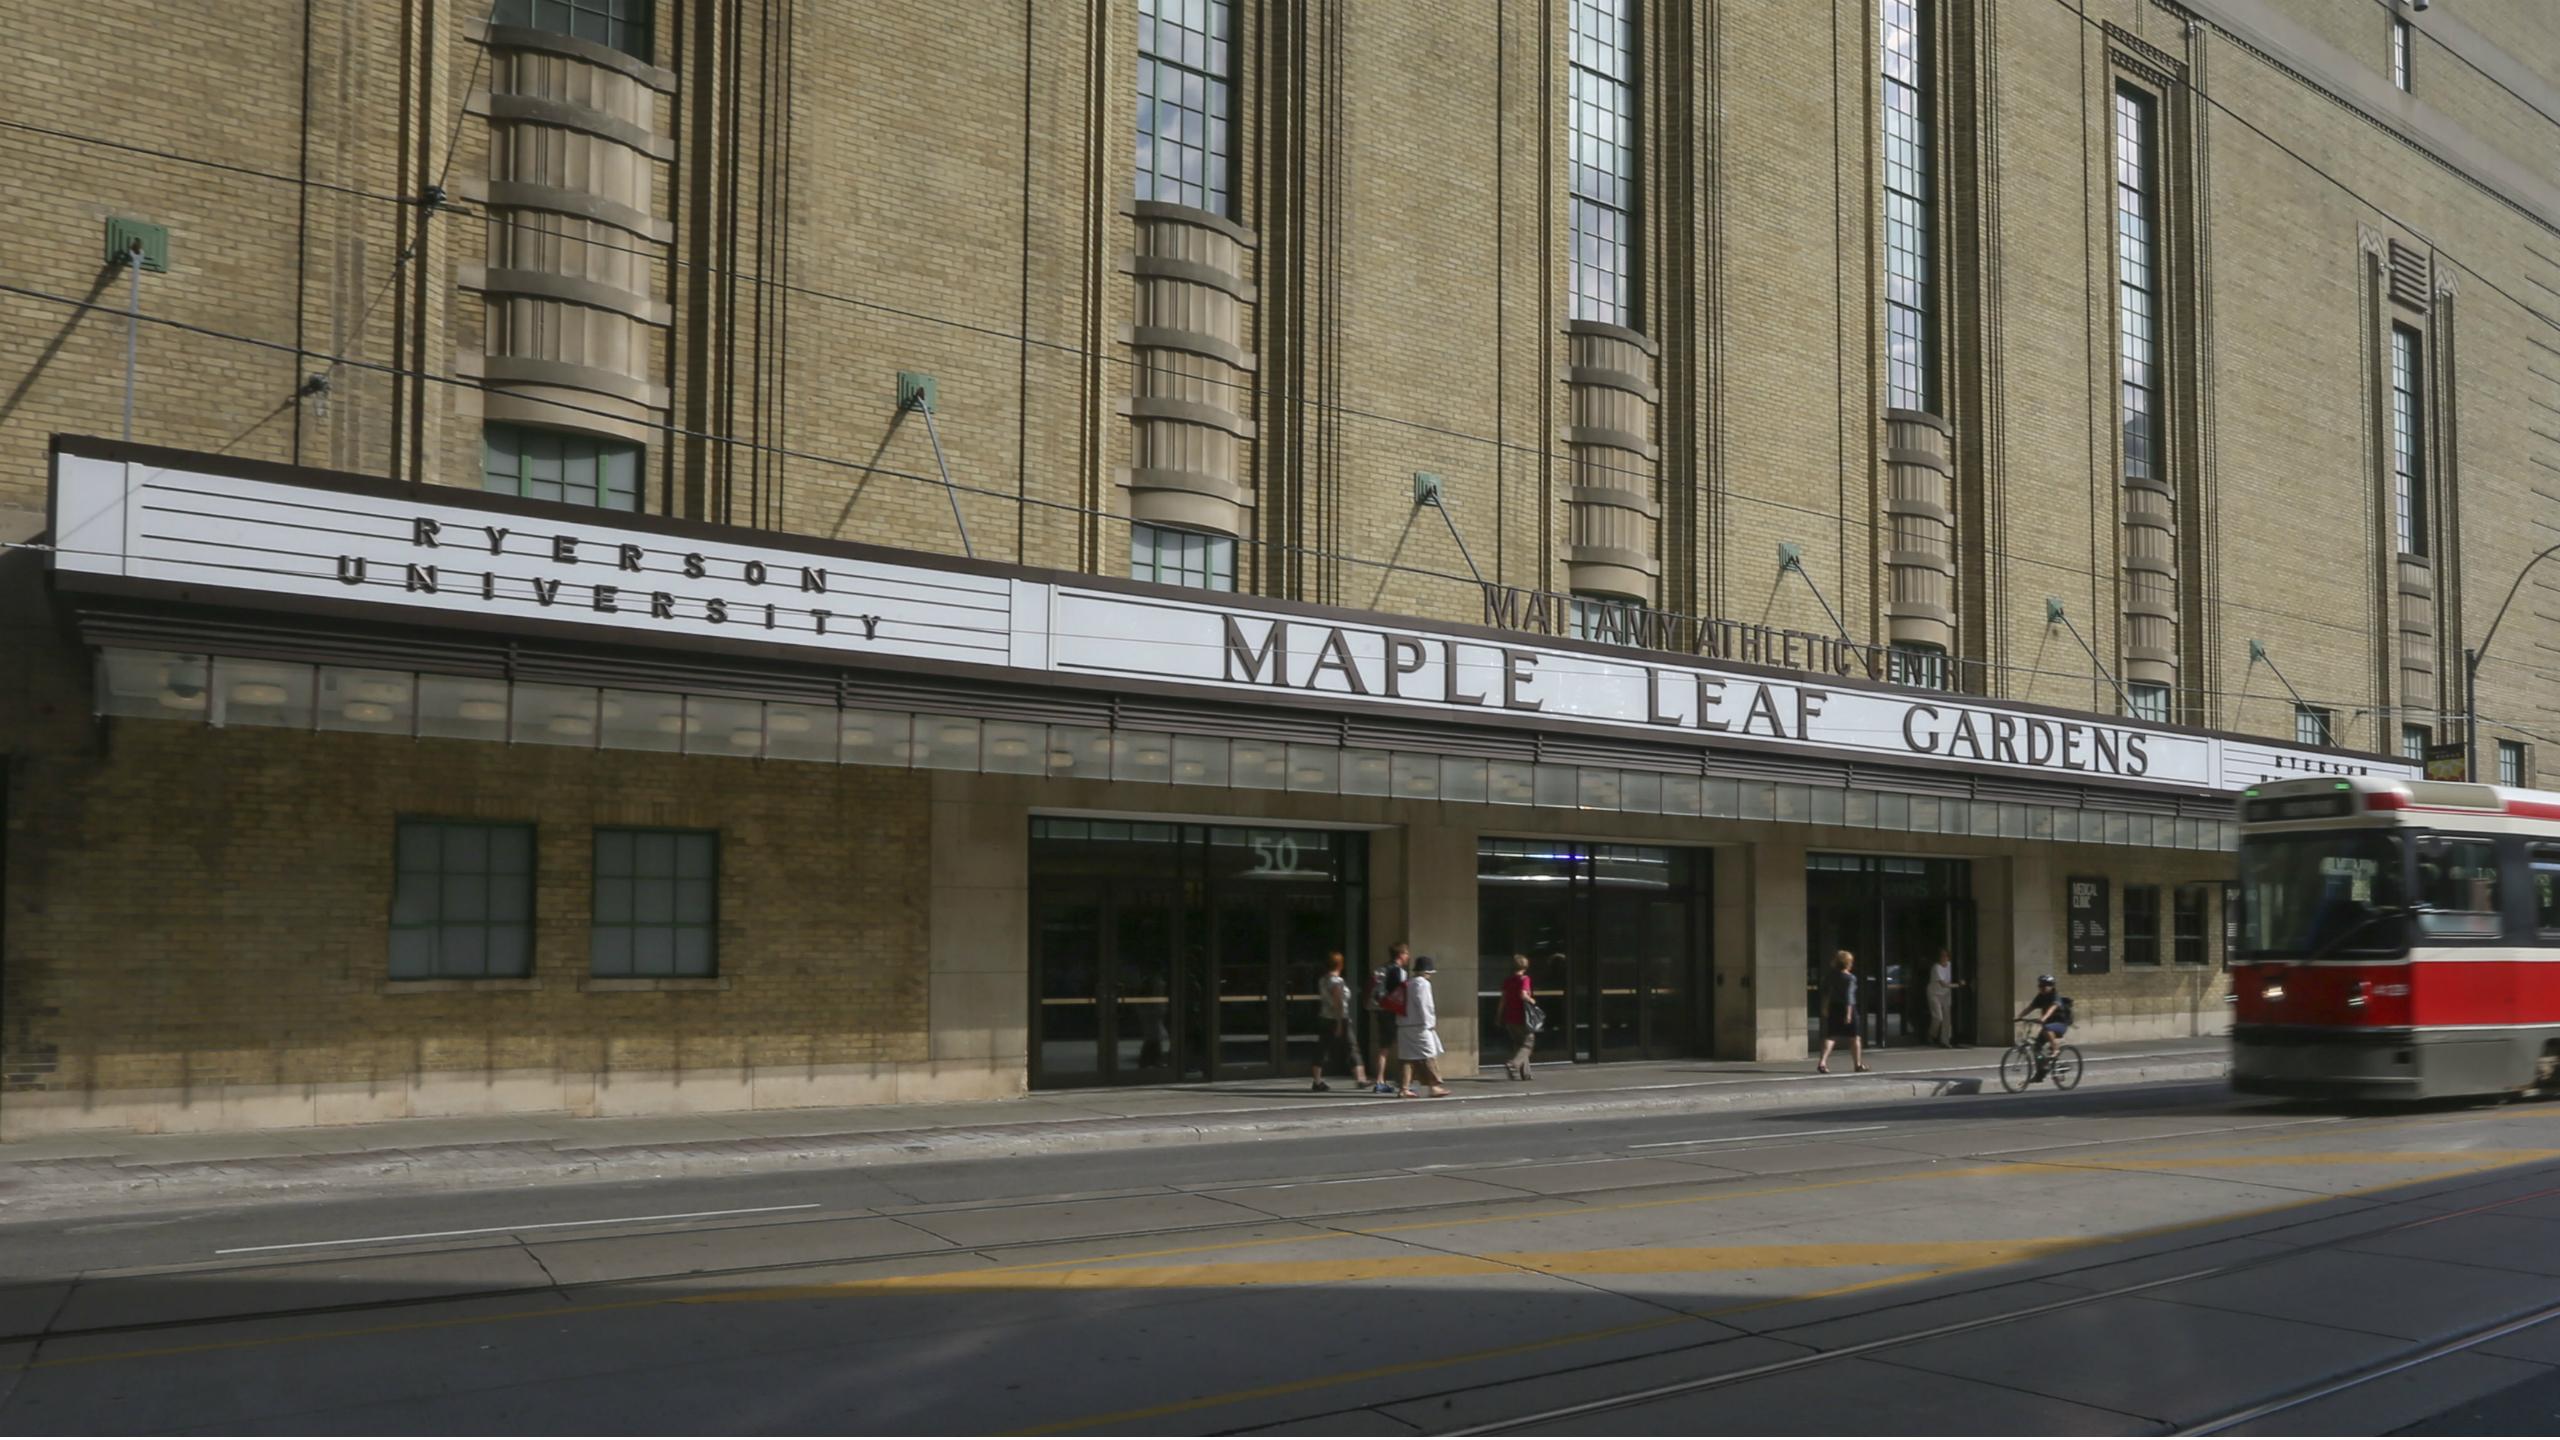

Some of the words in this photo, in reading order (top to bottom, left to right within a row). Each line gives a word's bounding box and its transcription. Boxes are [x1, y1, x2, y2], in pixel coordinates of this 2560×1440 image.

[337, 555, 880, 640] UNIVERSITY
[413, 516, 827, 594] RYERSON
[1484, 583, 1680, 651] MATTAMY
[1694, 616, 1850, 677] ATHLETIC
[1222, 614, 1544, 711] MAPLE
[1645, 667, 1828, 740] LEAF
[1903, 704, 2148, 776] GARDENS
[1254, 837, 1298, 873] 50
